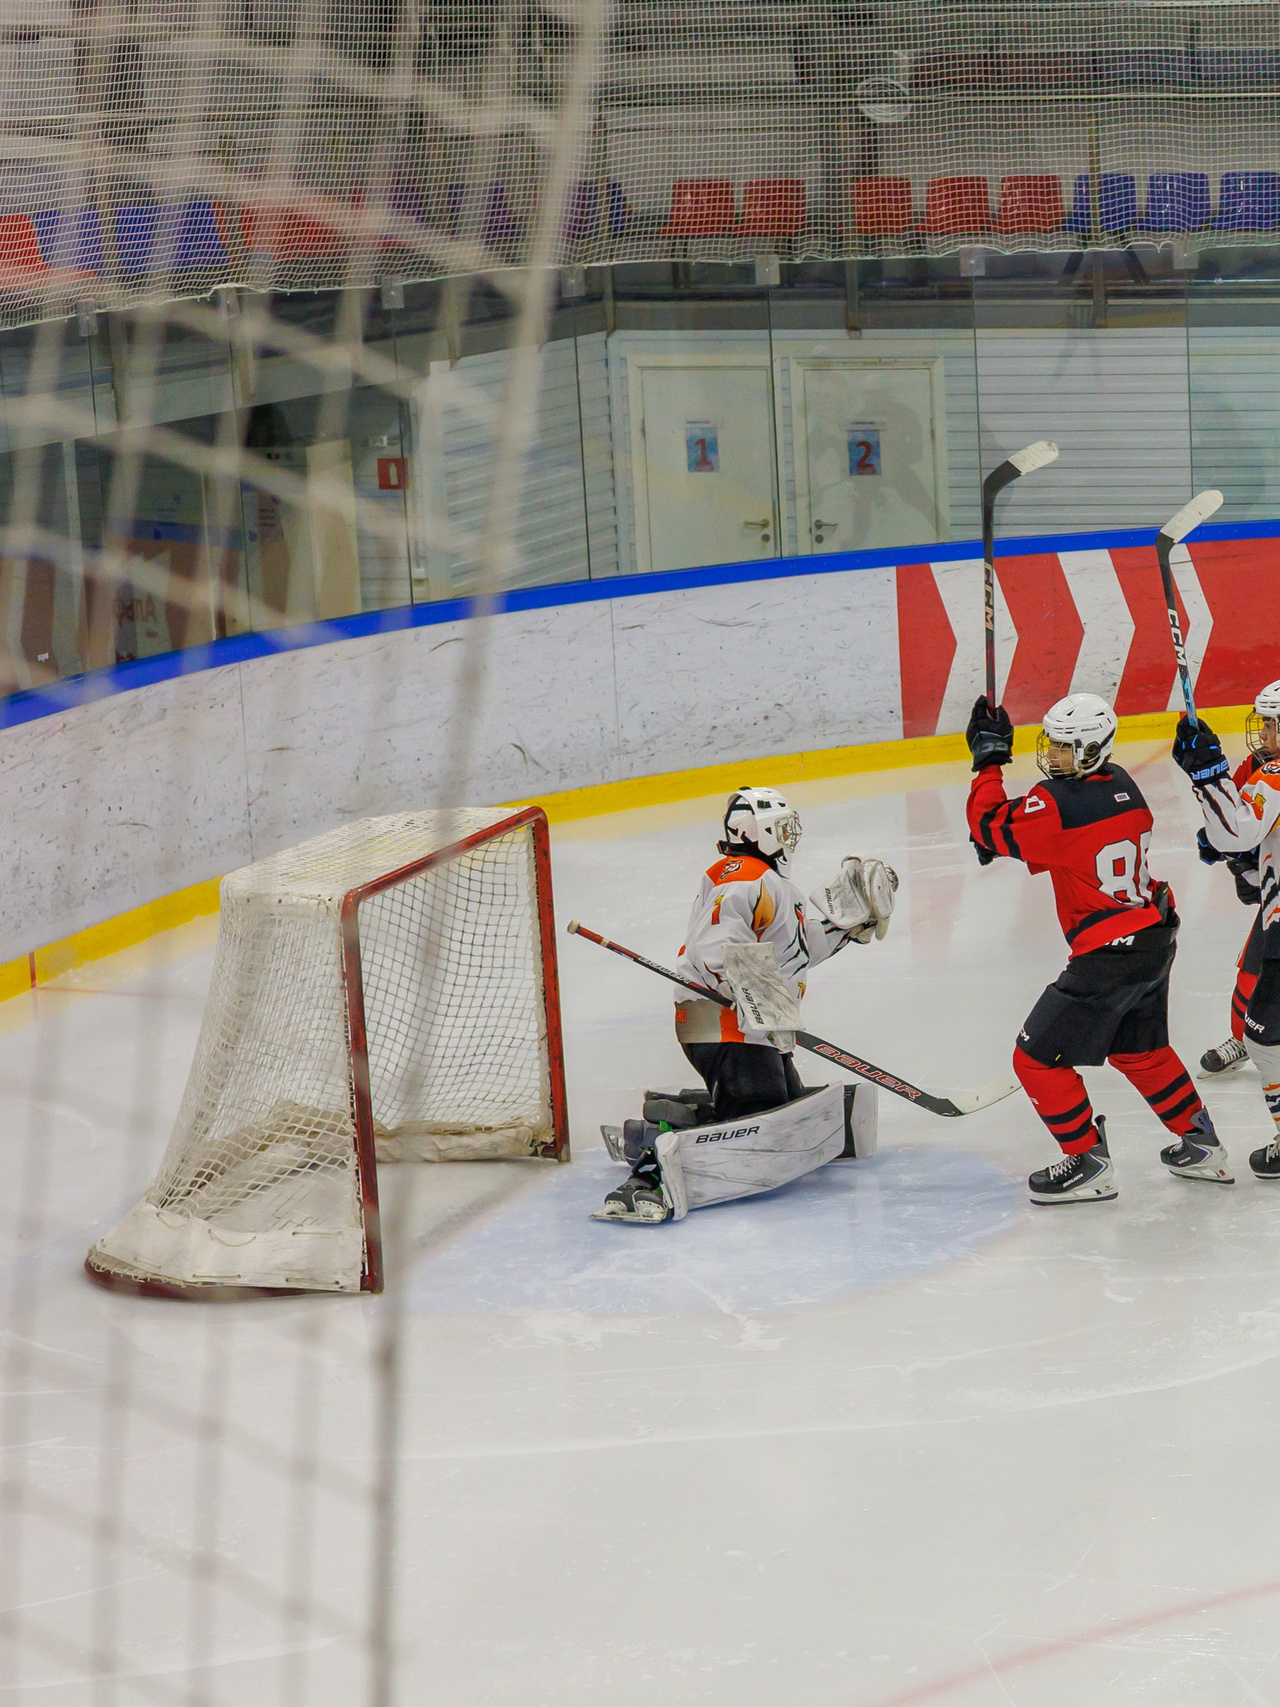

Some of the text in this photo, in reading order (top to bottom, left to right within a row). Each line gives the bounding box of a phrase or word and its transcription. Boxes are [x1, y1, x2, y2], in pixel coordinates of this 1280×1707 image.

[694, 438, 713, 467] 1
[855, 441, 876, 469] 2
[984, 562, 994, 632] CCM
[1168, 608, 1187, 666] CCM
[1190, 760, 1229, 780] AUER
[741, 987, 765, 1025] BAUER
[813, 1043, 922, 1101] BAUER
[695, 1125, 760, 1145] BAUER
